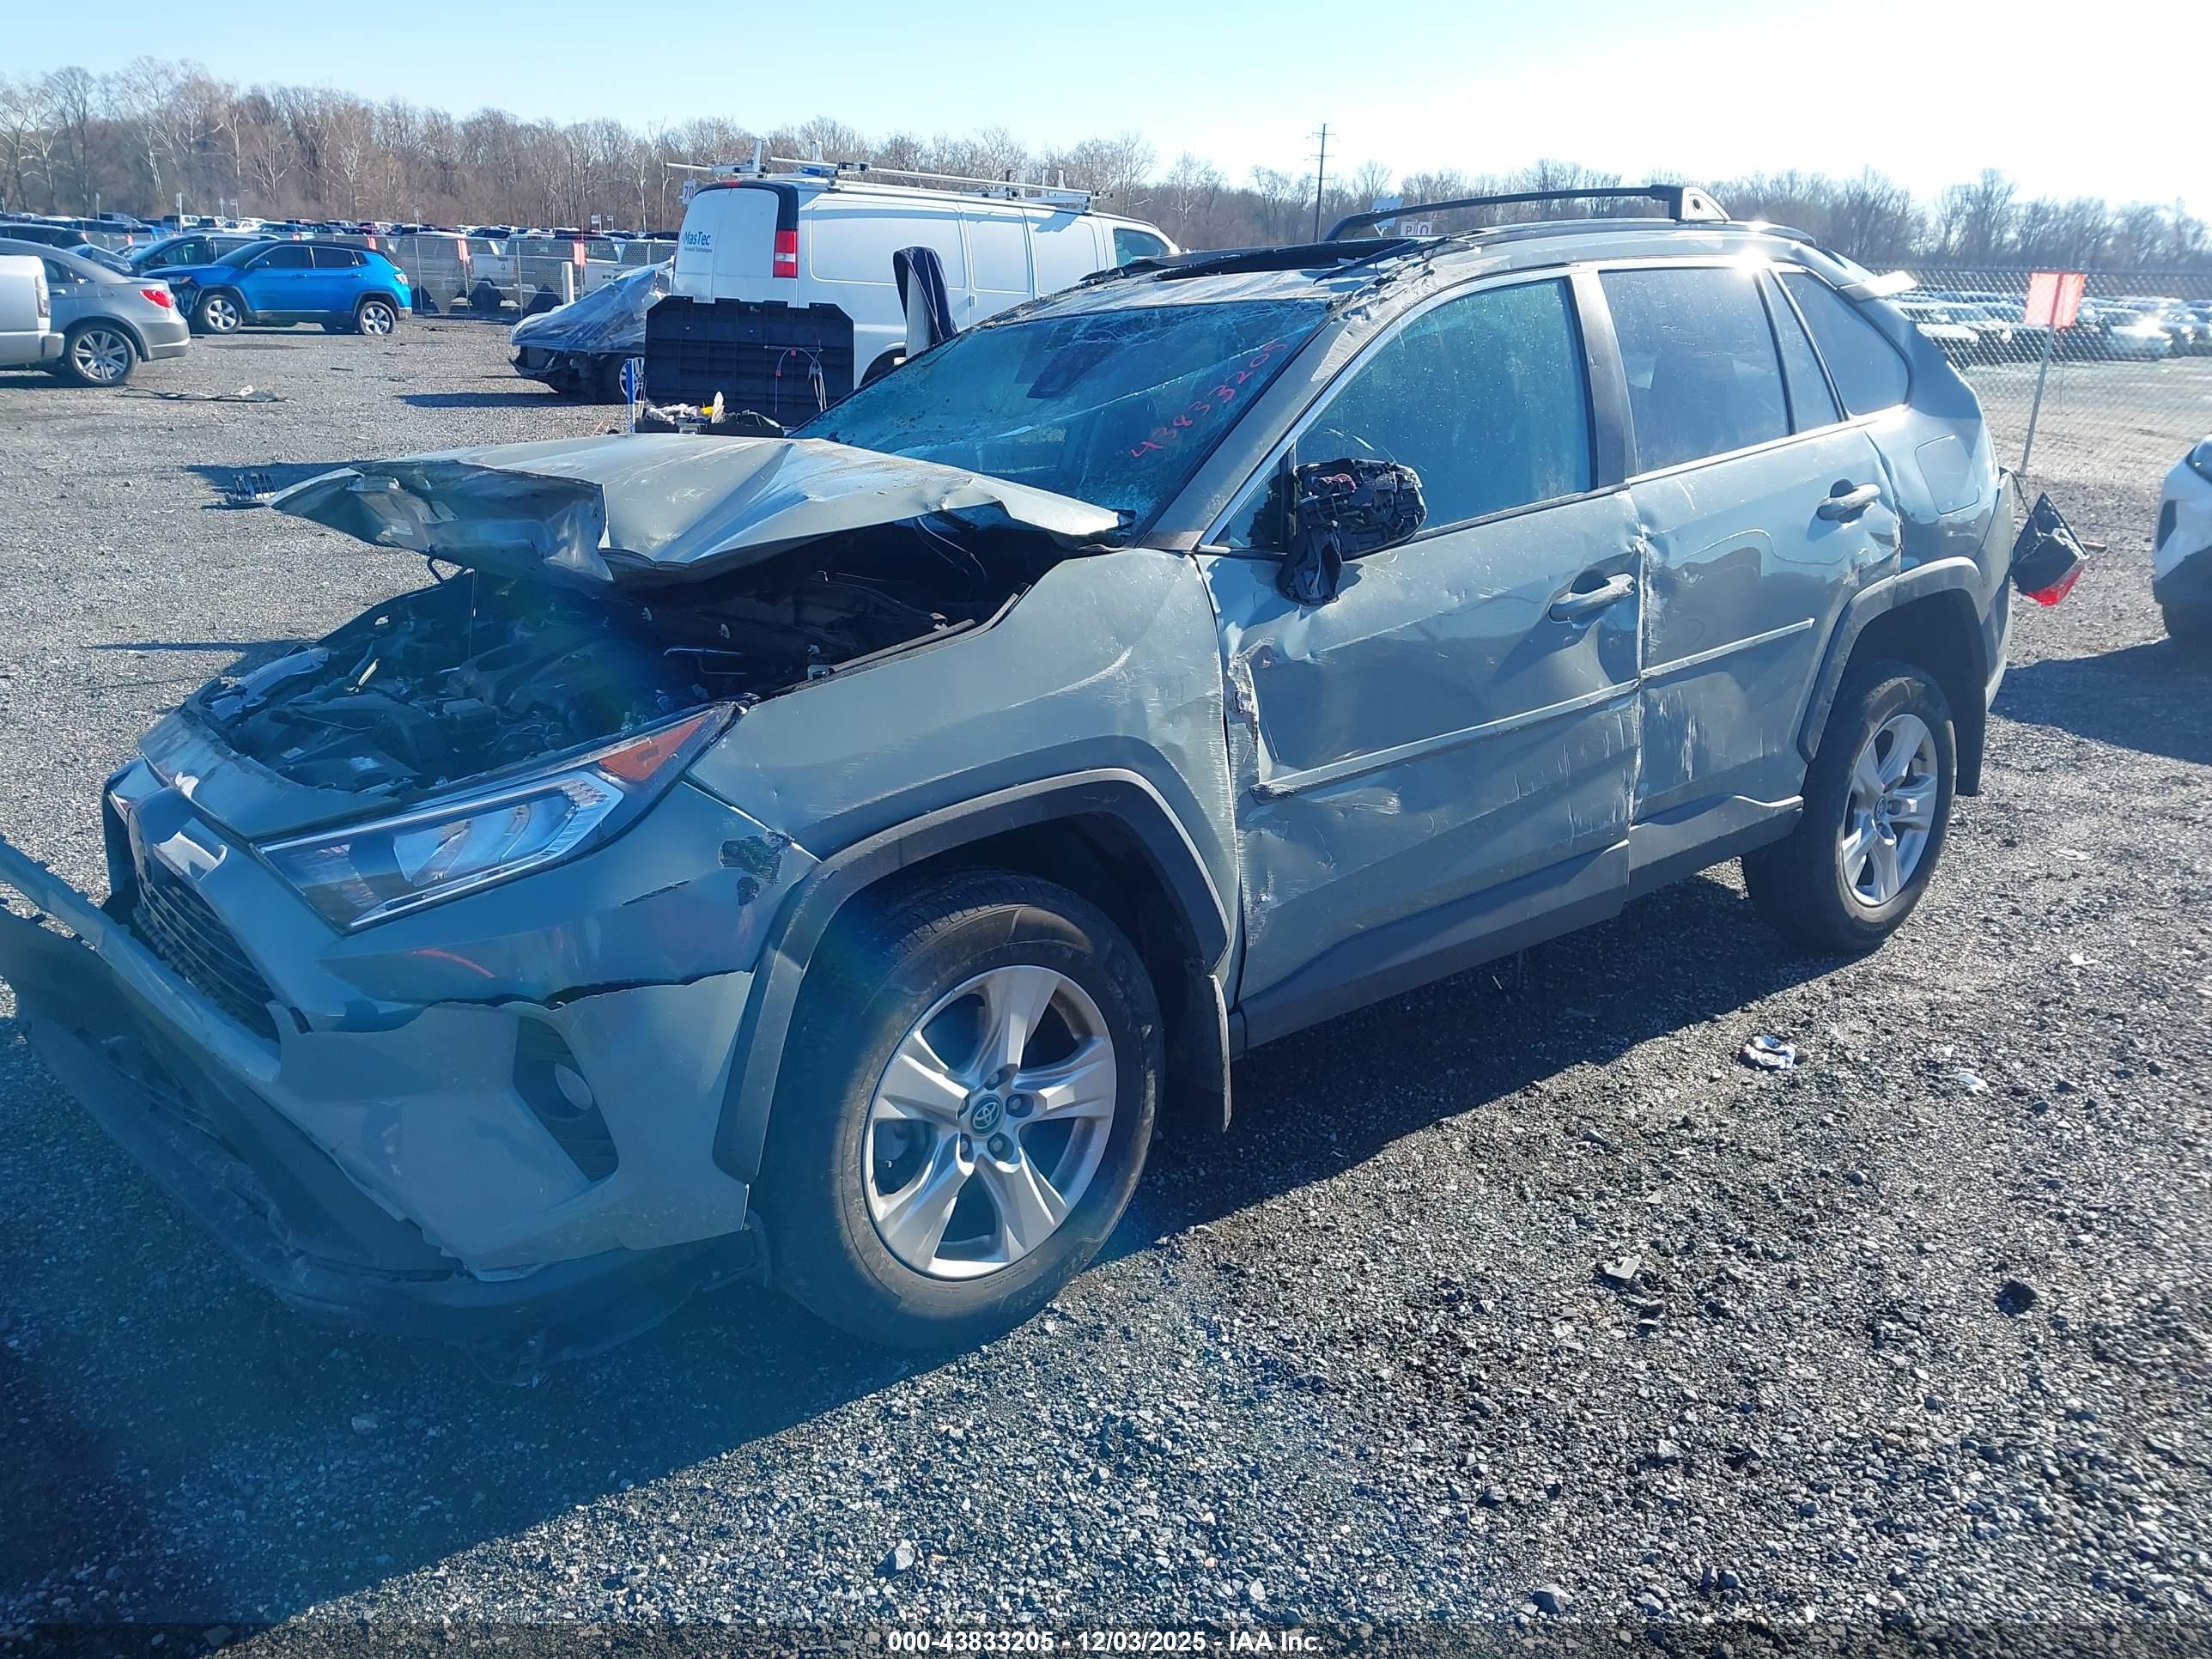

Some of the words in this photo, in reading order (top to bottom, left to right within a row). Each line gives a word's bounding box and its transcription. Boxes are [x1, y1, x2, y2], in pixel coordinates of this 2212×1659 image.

[684, 185, 695, 200] 70
[1405, 225, 1413, 236] P
[684, 231, 711, 246] MasTec
[1129, 342, 1288, 458] 43833205
